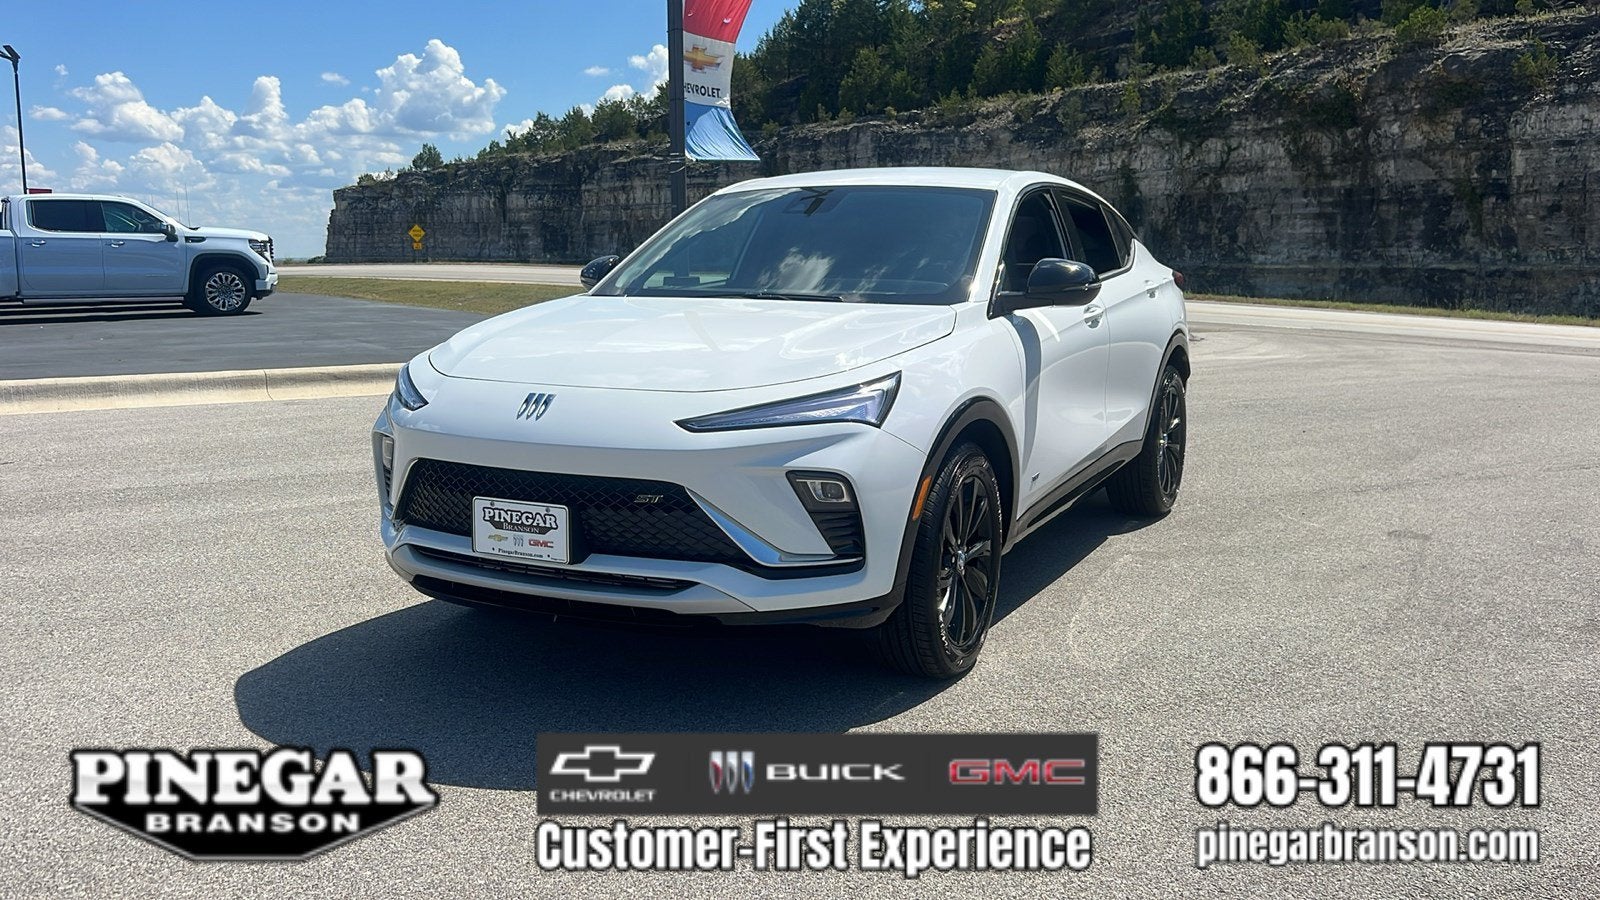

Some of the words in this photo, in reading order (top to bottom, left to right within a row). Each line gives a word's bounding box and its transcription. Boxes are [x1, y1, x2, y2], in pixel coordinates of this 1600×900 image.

[634, 494, 664, 503] ST
[484, 508, 557, 528] PINEGAR
[528, 538, 554, 549] GMC
